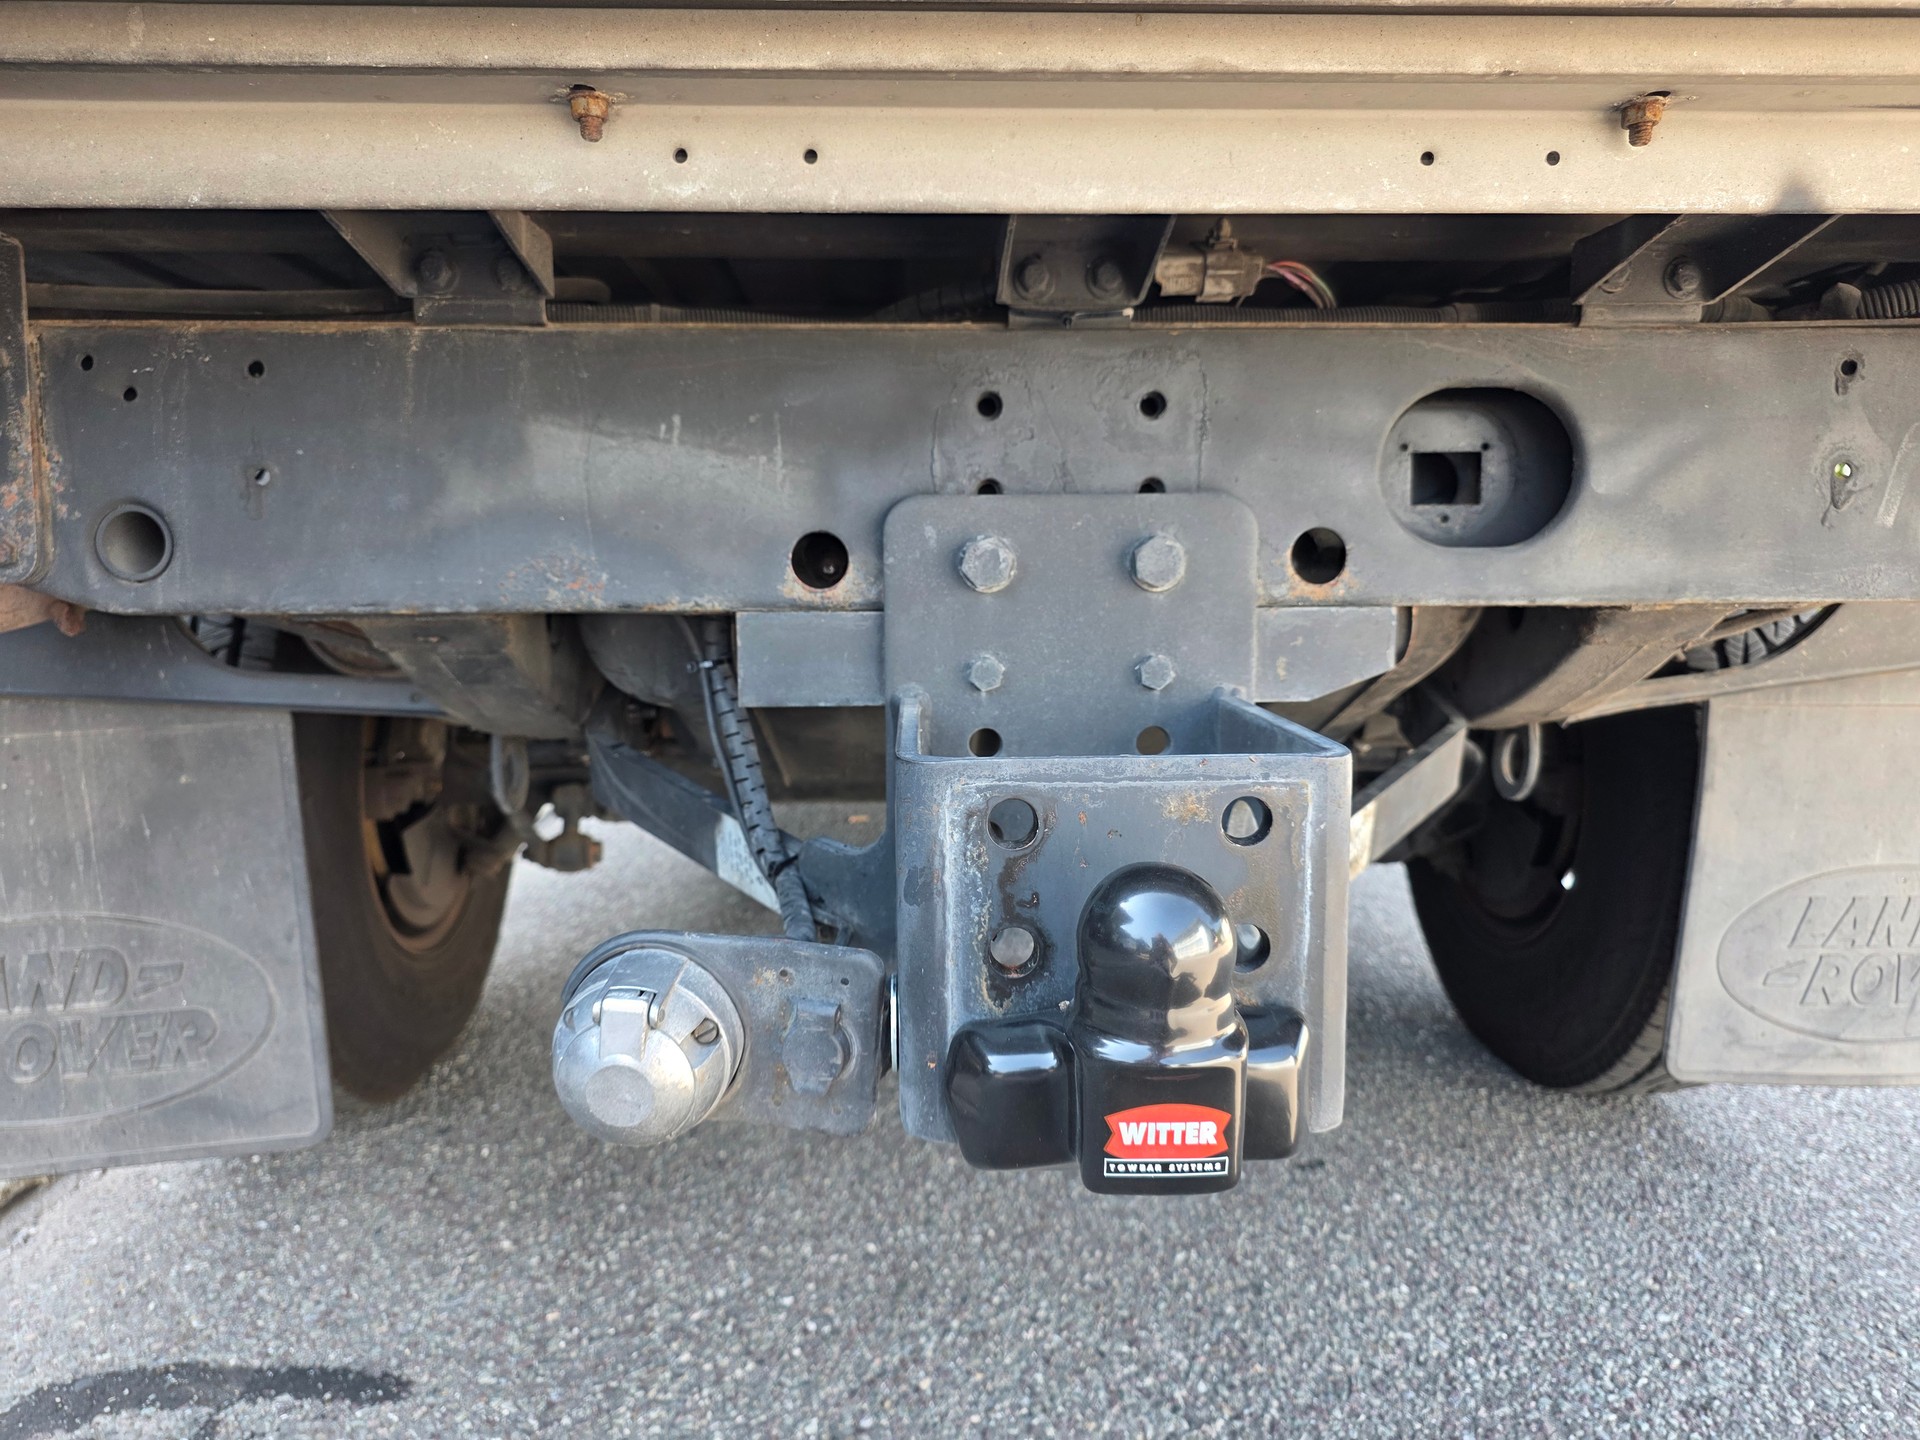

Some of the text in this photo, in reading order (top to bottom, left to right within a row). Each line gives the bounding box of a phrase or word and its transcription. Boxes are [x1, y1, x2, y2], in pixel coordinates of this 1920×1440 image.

[1786, 895, 1920, 949] LAN
[0, 946, 128, 1014] ND
[3, 1005, 219, 1084] OVER
[1118, 1121, 1217, 1146] WITTER
[1109, 1162, 1221, 1173] TOWBAR SYSTEMS
